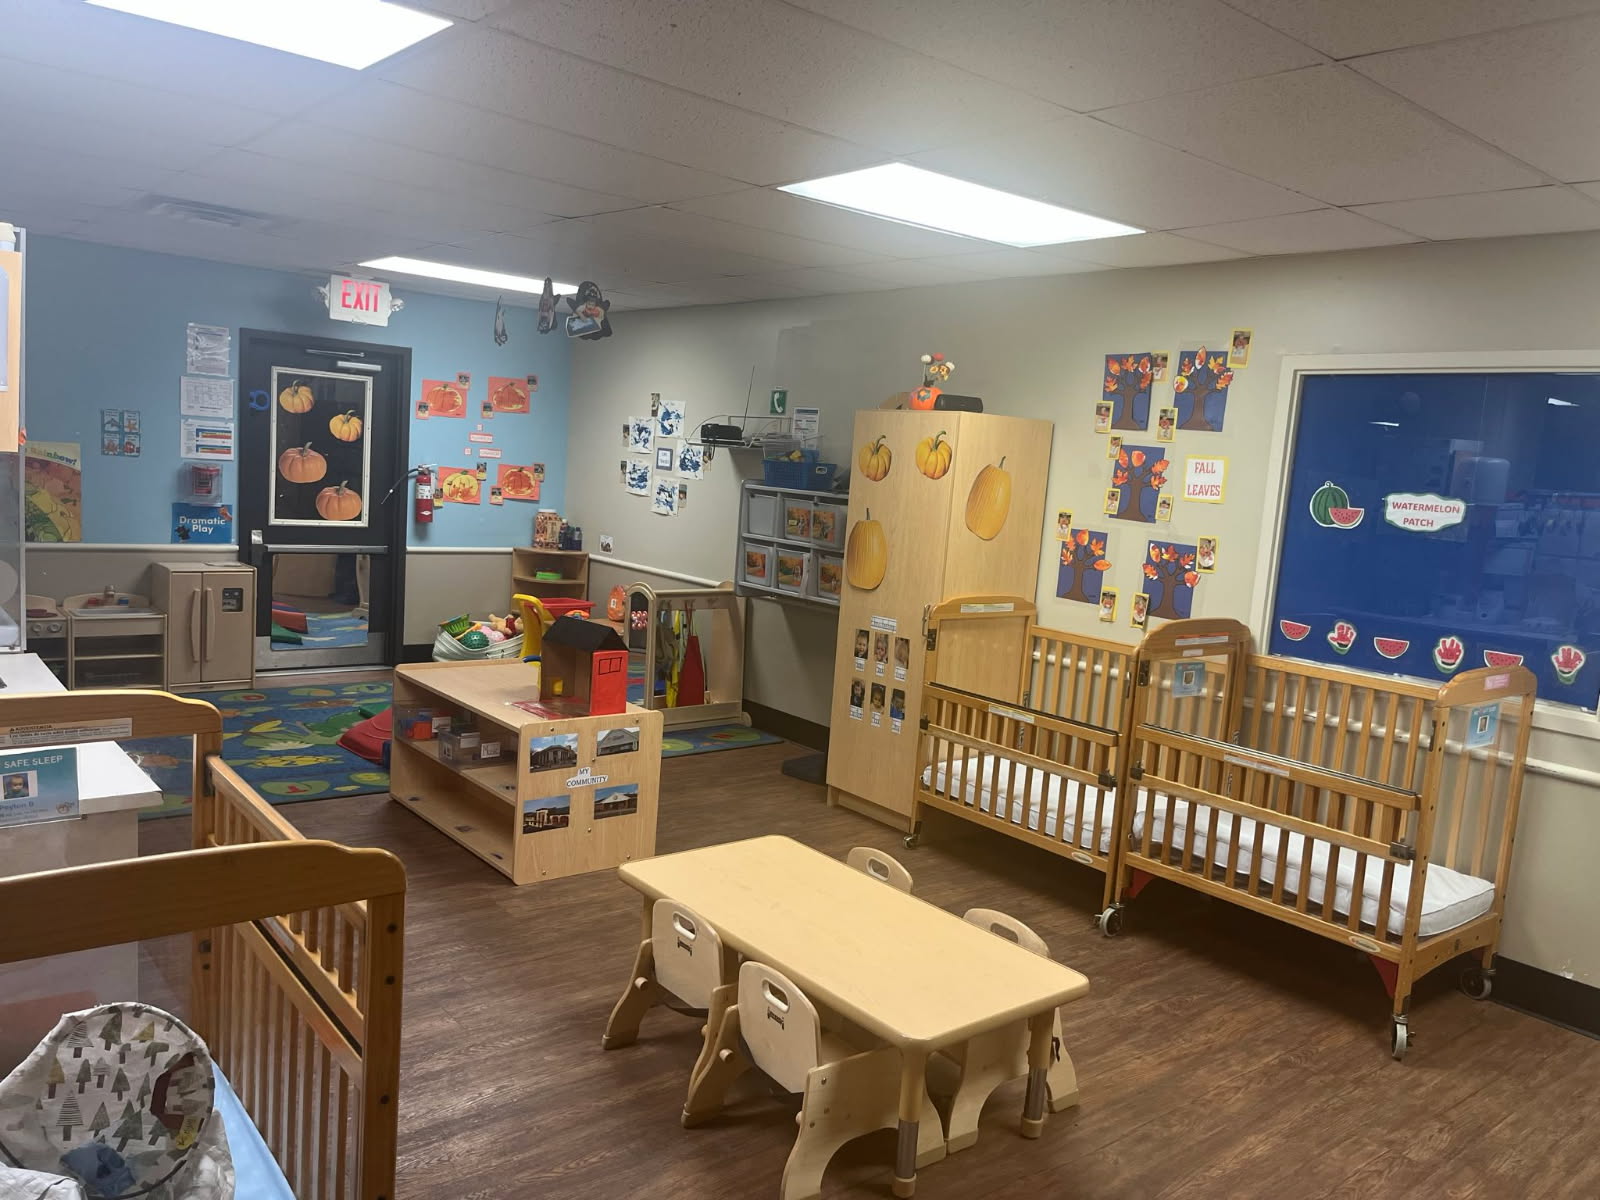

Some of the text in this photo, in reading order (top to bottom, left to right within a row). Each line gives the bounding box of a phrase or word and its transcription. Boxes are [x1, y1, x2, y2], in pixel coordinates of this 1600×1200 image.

[341, 279, 383, 313] EXIT
[1194, 461, 1216, 474] FALL
[1187, 484, 1221, 497] LEAVES
[1392, 501, 1460, 514] WATERMELON
[179, 516, 226, 525] Dramatic
[1403, 517, 1434, 527] PATCH
[192, 524, 214, 535] Play
[4, 755, 63, 769] SAFE SLEEP
[566, 775, 608, 787] COMMUNITY
